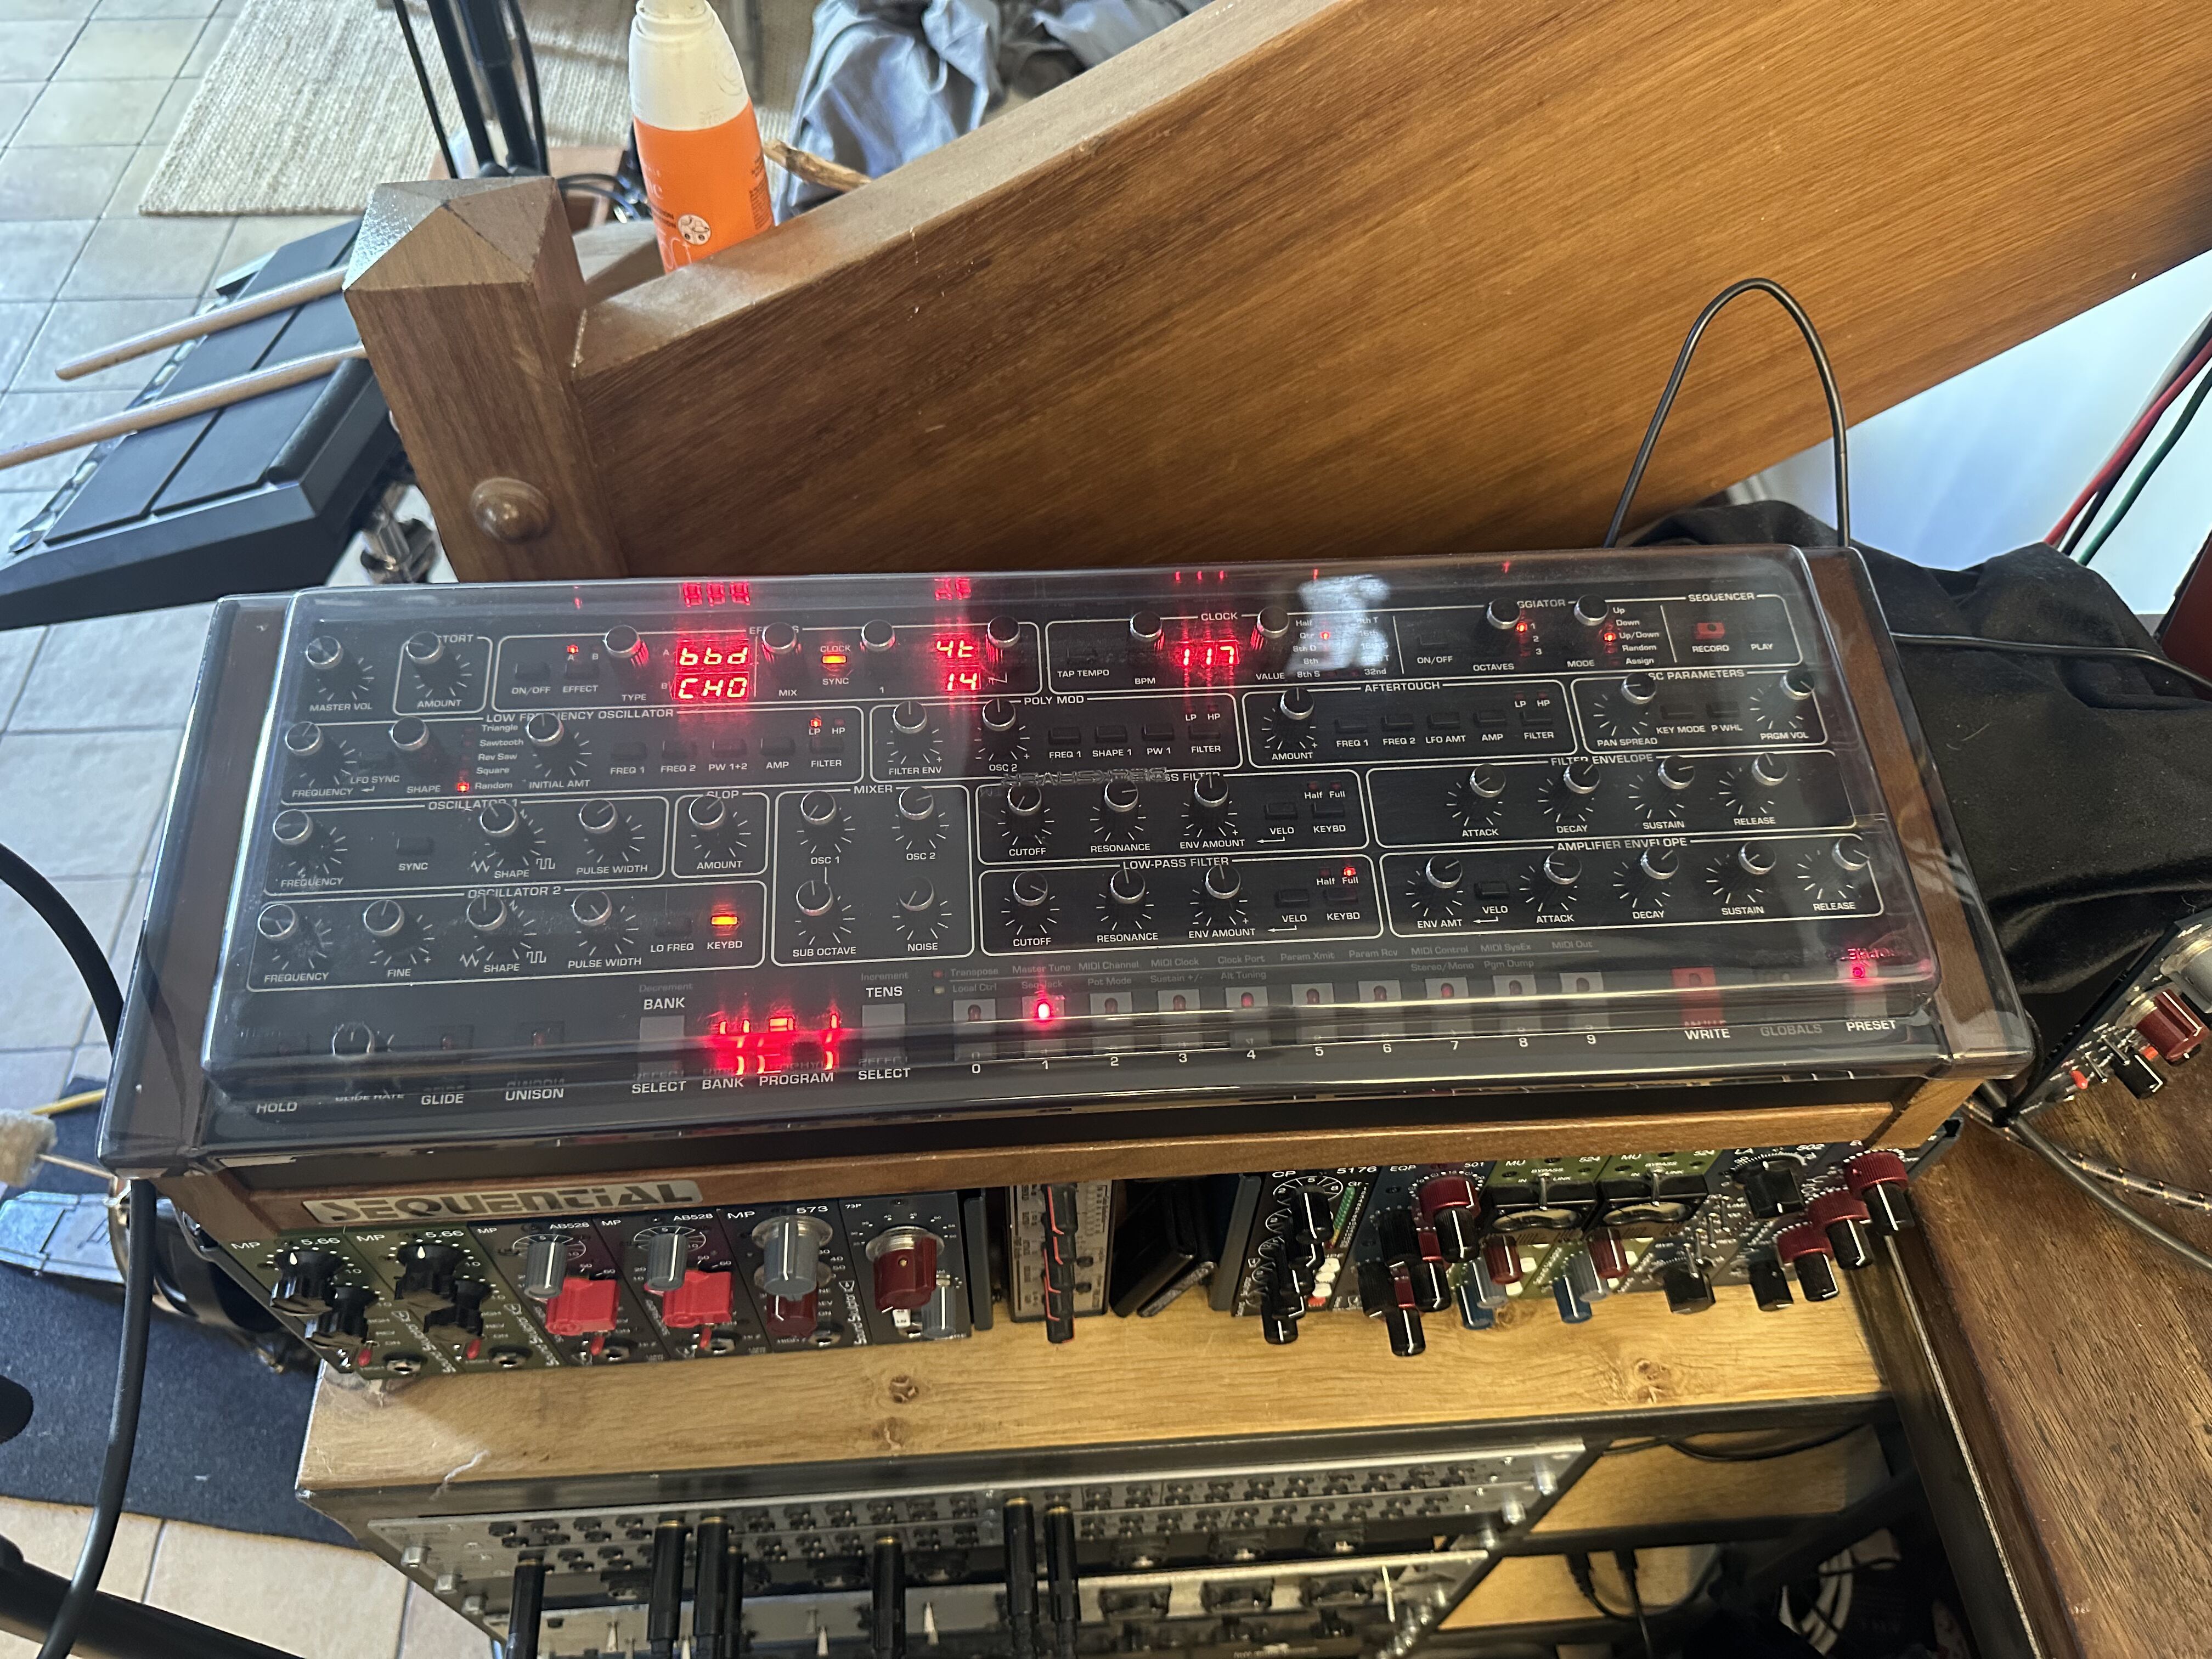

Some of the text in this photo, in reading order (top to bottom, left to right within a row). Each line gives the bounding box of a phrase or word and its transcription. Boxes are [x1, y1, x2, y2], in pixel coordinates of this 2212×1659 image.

[1688, 593, 1754, 602] SEQUENCER
[1200, 612, 1238, 621] CLOCK
[1692, 645, 1729, 653] RECORD
[1417, 656, 1453, 665] ON/OFF
[1567, 659, 1595, 668] MODE
[1473, 663, 1514, 672] OCTAVES
[1077, 669, 1110, 677] TEMPO
[511, 686, 551, 696] ON/OFF
[1364, 682, 1440, 692] AFTERTOUCH
[417, 699, 461, 708] AMOUNT
[1024, 696, 1084, 706] POLY MOD
[1524, 731, 1554, 740] FILTER
[479, 738, 523, 747] Sawtooth
[1620, 737, 1658, 746] SPREAD
[1191, 745, 1221, 753] FILTER
[1272, 752, 1313, 760] AMOUNT
[766, 761, 789, 769] AMP
[811, 759, 842, 768] FILTER
[889, 767, 919, 775] FILTER
[292, 788, 353, 798] FREQUENCY
[407, 785, 441, 794] SHAPE
[854, 785, 893, 794] MIXER
[1643, 821, 1685, 830] SUSTAIN
[1734, 817, 1776, 826] RELEASE
[1313, 825, 1346, 833] KEYBD
[1462, 828, 1499, 837] ATTACK
[1556, 825, 1588, 833] DECAY
[1091, 843, 1150, 853] RESONANCE
[1180, 839, 1245, 849] ENV AMOUNT
[1009, 848, 1046, 856] CUTOFF
[398, 862, 428, 871] SYNC
[576, 865, 648, 874] PULSE WIDTH
[697, 861, 742, 870] AMOUNT
[494, 870, 529, 878] SHAPE
[280, 877, 343, 887] FREQUENCY
[1482, 906, 1508, 914] VELO
[1722, 906, 1764, 915] SUSTAIN
[1813, 902, 1857, 911] RELEASE
[1282, 915, 1307, 923] VELO
[1327, 912, 1361, 921] KEYBD
[1536, 915, 1575, 924] ATTACK
[1632, 911, 1665, 919] DECAY
[1013, 938, 1052, 947] CUTOFF
[1097, 933, 1159, 943] RESONANCE
[707, 941, 742, 950] KEYBD
[907, 943, 938, 951] NOISE
[1481, 943, 1531, 952] MIDI SysEx
[1552, 941, 1573, 949] MIDI
[1348, 950, 1379, 958] Param
[1435, 946, 1468, 954] Control
[1218, 956, 1242, 964] Clock
[1280, 953, 1310, 961] Param
[568, 958, 641, 969] PULSE WIDTH
[1079, 961, 1139, 970] MIDI Channel
[1150, 958, 1199, 967] MIDI Clock
[1411, 962, 1474, 972] Stereo/Mono
[1484, 960, 1534, 970] Pgm Dump
[483, 964, 520, 973] SHAPE
[950, 968, 998, 977] Transpose
[1012, 965, 1046, 974] Master
[264, 973, 329, 983] FREQUENCY
[861, 972, 909, 981] Increment
[1221, 971, 1267, 980] Alt Tuning
[1087, 977, 1132, 986] Pot Mode
[639, 983, 693, 993] Decrement
[866, 986, 902, 998] TENS
[953, 983, 996, 992] Local Ctrl
[644, 997, 685, 1010] BANK
[1760, 1024, 1822, 1036] GLOBALS
[1846, 1020, 1897, 1031] PRESET
[1684, 1028, 1731, 1040] WRITE
[1519, 1037, 1528, 1047] 8
[1587, 1035, 1596, 1044] 9
[1383, 1043, 1392, 1053] 6
[1451, 1041, 1459, 1050] 7
[1246, 1049, 1256, 1059] 4
[1315, 1046, 1324, 1056] 5
[1110, 1057, 1119, 1066] 2
[1179, 1053, 1188, 1063] 3
[972, 1064, 981, 1074] 0
[1042, 1060, 1048, 1070] 1
[859, 1068, 911, 1080] SELECT
[702, 1072, 834, 1090] BANK PROGRAM
[631, 1081, 686, 1094] SELECT
[421, 1093, 464, 1105] GLIDE
[505, 1088, 565, 1101] UNISON
[256, 1102, 298, 1114] HOLD
[1336, 1166, 1377, 1174] 5176
[321, 1183, 693, 1221] SEQUENTIAL
[797, 1206, 828, 1214] 573
[727, 1211, 755, 1220] MP
[356, 1233, 385, 1242] MP
[425, 1229, 464, 1238] 5.66
[231, 1241, 261, 1250] MP
[301, 1237, 341, 1246] 5.66
